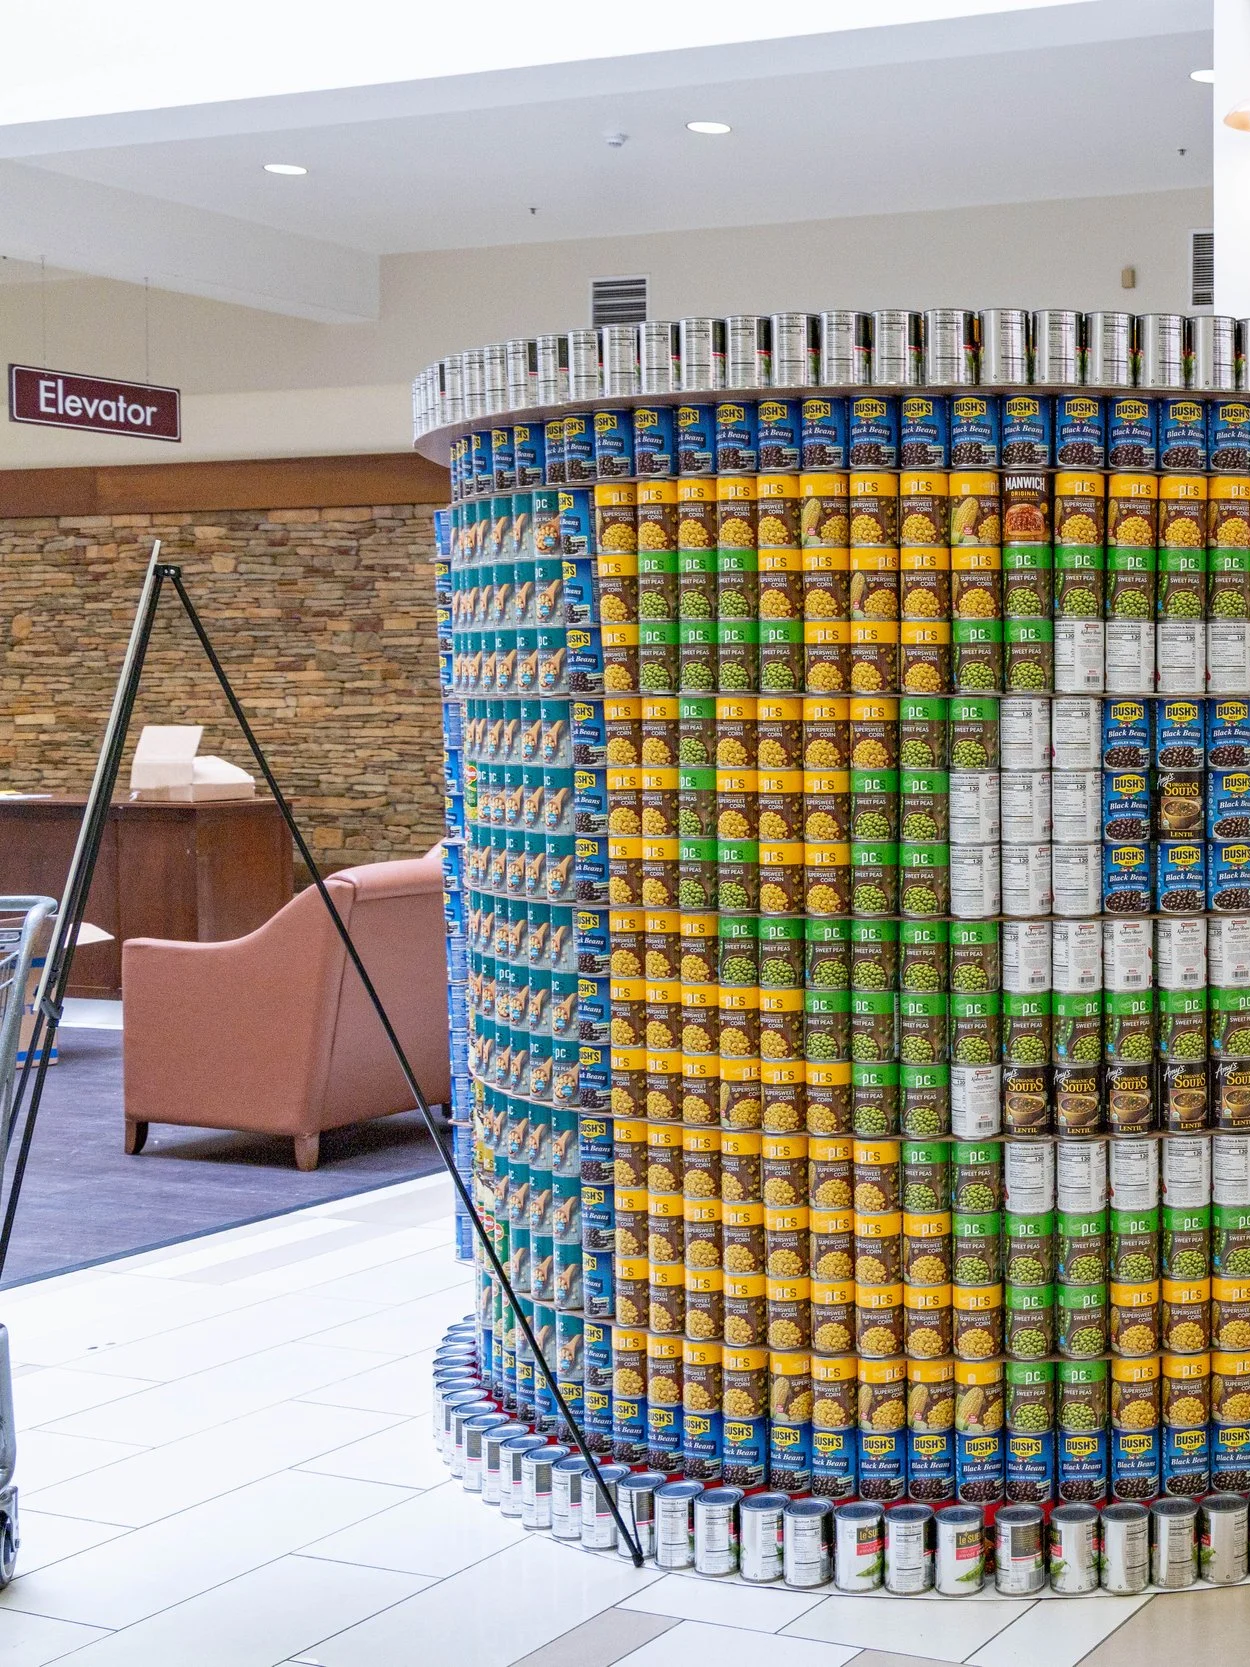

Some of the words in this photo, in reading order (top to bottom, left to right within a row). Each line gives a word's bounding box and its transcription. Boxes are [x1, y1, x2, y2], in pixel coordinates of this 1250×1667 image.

[39, 379, 157, 426] Elevator
[1008, 402, 1037, 412] BUSH'S
[1067, 403, 1098, 413] BUSH'S
[854, 404, 885, 413] BUSH'S
[1117, 405, 1148, 415] BUSH'S
[1172, 407, 1201, 417] BUSH'S
[1221, 407, 1250, 418] BUSH'S
[870, 426, 890, 435] Beans
[1023, 425, 1043, 434] Beans
[1063, 426, 1079, 434] Black
[1113, 427, 1129, 437] Black
[1167, 430, 1184, 438] Black
[1217, 432, 1234, 440] Black
[911, 479, 932, 494] pics
[1006, 477, 1045, 492] MANWICH
[1075, 479, 1095, 495] pics
[1132, 481, 1151, 497] pics
[729, 484, 749, 499] pics
[1179, 483, 1199, 498] pics
[613, 490, 633, 505] pics
[812, 554, 832, 570] pics
[914, 554, 936, 569] pics
[972, 554, 992, 569] pics
[817, 628, 839, 643] pics
[917, 628, 937, 643] pics
[814, 705, 835, 720] pics
[1112, 706, 1143, 716] BUSH'S
[1167, 706, 1197, 716] BUSH'S
[1218, 706, 1248, 716] BUSH'S
[1129, 730, 1146, 738] Beans
[1183, 730, 1200, 738] Beans
[1213, 729, 1232, 737] Black
[1115, 778, 1145, 788] BUSH'S
[1157, 773, 1175, 790] Amy's
[1225, 778, 1250, 789] BUSH'S
[1164, 783, 1198, 795] SOUPS
[1114, 851, 1144, 862] BUSH'S
[1171, 850, 1199, 861] BUSH'S
[1224, 849, 1250, 859] BUSH'S
[1110, 874, 1128, 882] Black
[1003, 1068, 1019, 1083] Amy's
[1106, 1066, 1124, 1082] Amy's
[1164, 1065, 1186, 1081] Amy's
[1215, 1062, 1239, 1079] Amy's
[1054, 1069, 1072, 1085] Amy's
[1174, 1073, 1206, 1088] SOUPS
[1008, 1078, 1043, 1091] SOUPS
[1061, 1078, 1096, 1092] SOUPS
[1113, 1076, 1147, 1090] SOUPS
[690, 1137, 710, 1150] pics
[828, 1146, 848, 1162] pics
[1134, 1292, 1152, 1306] pics
[1134, 1366, 1153, 1380] pics
[1221, 1431, 1249, 1442] BUSH'S
[864, 1439, 894, 1449] BUSH'S
[915, 1438, 945, 1449] BUSH'S
[967, 1441, 998, 1452] BUSH'S
[1011, 1441, 1040, 1452] BUSH'S
[1067, 1441, 1097, 1451] BUSH'S
[1122, 1438, 1152, 1449] BUSH'S
[879, 1461, 899, 1469] Beans
[912, 1461, 928, 1469] Black
[930, 1461, 950, 1469] Beans
[963, 1464, 982, 1473] Black
[1063, 1463, 1080, 1471] Black
